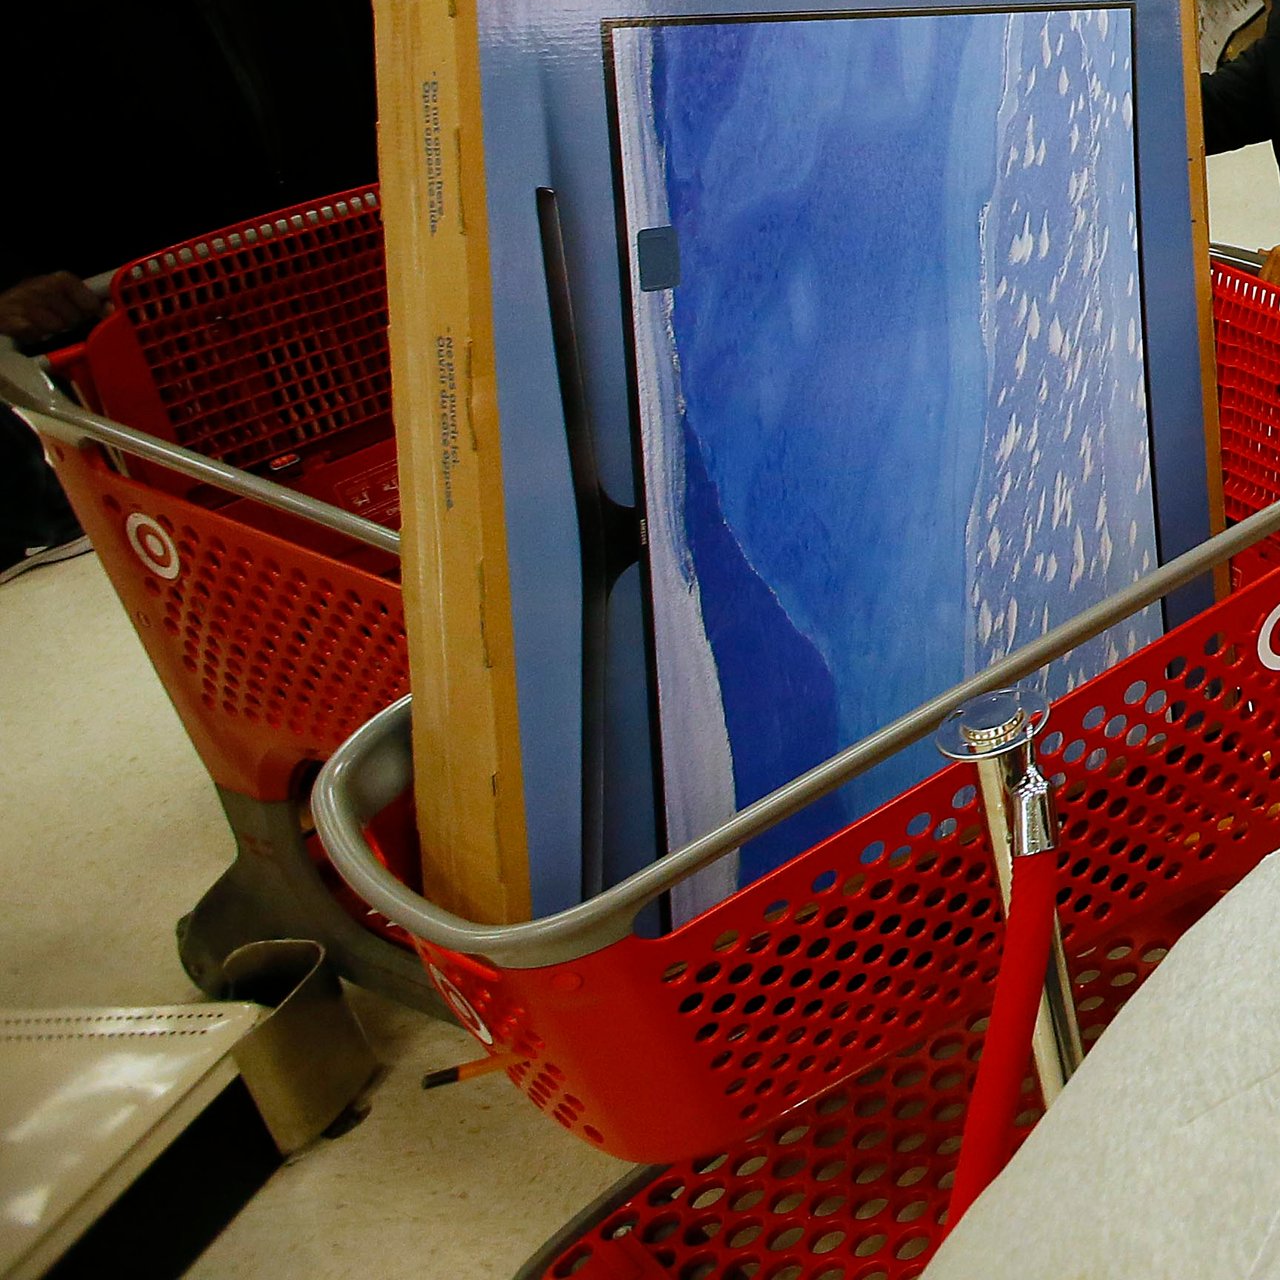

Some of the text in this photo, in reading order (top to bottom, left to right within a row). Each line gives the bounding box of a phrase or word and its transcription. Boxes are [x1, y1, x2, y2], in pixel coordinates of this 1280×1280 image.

[422, 81, 431, 125] Open
[433, 106, 442, 133] not
[424, 127, 436, 197] opposite
[433, 137, 442, 177] open
